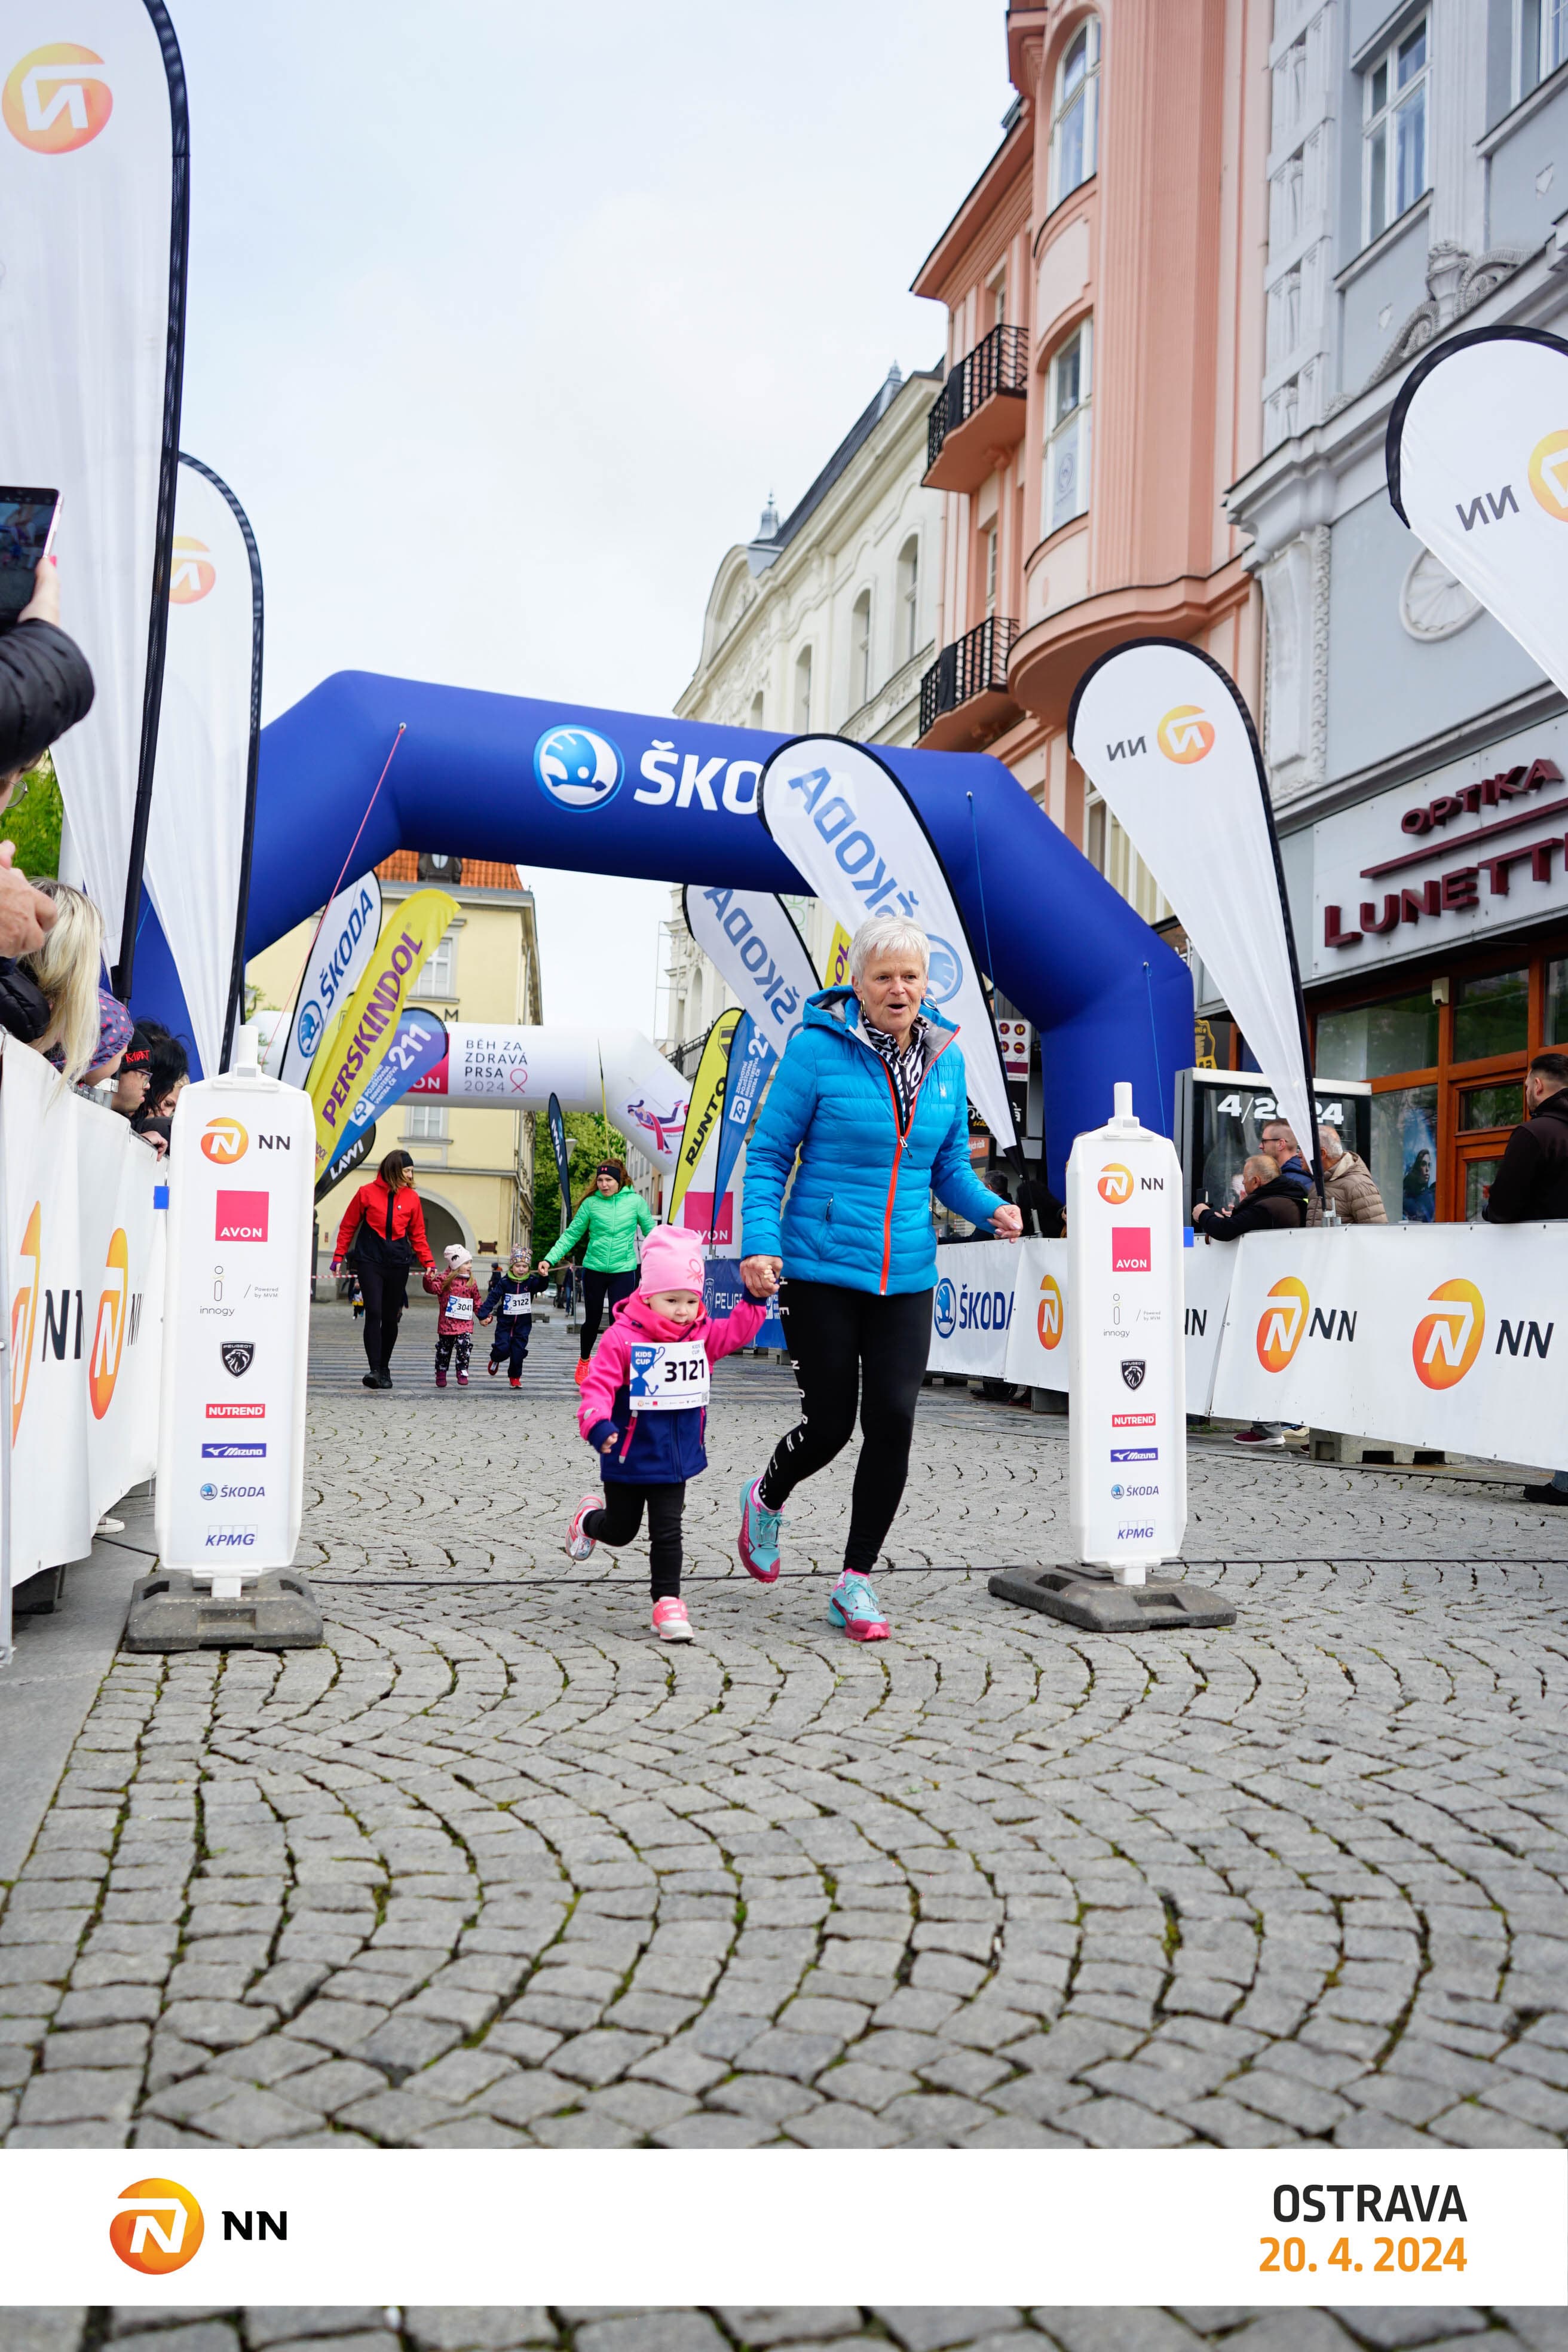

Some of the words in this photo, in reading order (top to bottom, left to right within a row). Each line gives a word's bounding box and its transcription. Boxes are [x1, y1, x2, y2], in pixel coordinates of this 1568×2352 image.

[633, 740, 764, 815] ŠKO
[1401, 758, 1564, 834] OPTIKA
[1325, 832, 1568, 948] LUNETT
[320, 887, 373, 1009] ŠKODA
[321, 932, 422, 1128] PERSKINDOL
[389, 1023, 431, 1070] 211
[503, 1042, 522, 1051] ZA
[465, 1052, 528, 1065] ZDRAVÁ
[465, 1066, 503, 1078] PRSA
[464, 1080, 505, 1093] 2024
[685, 1077, 726, 1166] RUNTO
[258, 1134, 290, 1150] NN
[330, 1139, 364, 1180] LAWI
[1141, 1177, 1164, 1190] NN
[220, 1227, 262, 1238] AVON
[1116, 1259, 1147, 1269] AVON
[513, 1298, 529, 1307] 3122
[200, 1306, 235, 1316] innogy
[1309, 1307, 1358, 1342] NN
[1104, 1328, 1130, 1337] innogy
[1495, 1319, 1554, 1359] NN
[664, 1359, 704, 1382] 3121
[209, 1406, 262, 1416] NUTREND
[1114, 1416, 1154, 1425] NUTREND
[220, 1484, 265, 1497] ŠKODA
[1126, 1485, 1159, 1496] ŠKODA
[205, 1533, 255, 1546] KPMG
[1117, 1527, 1153, 1540] KPMG
